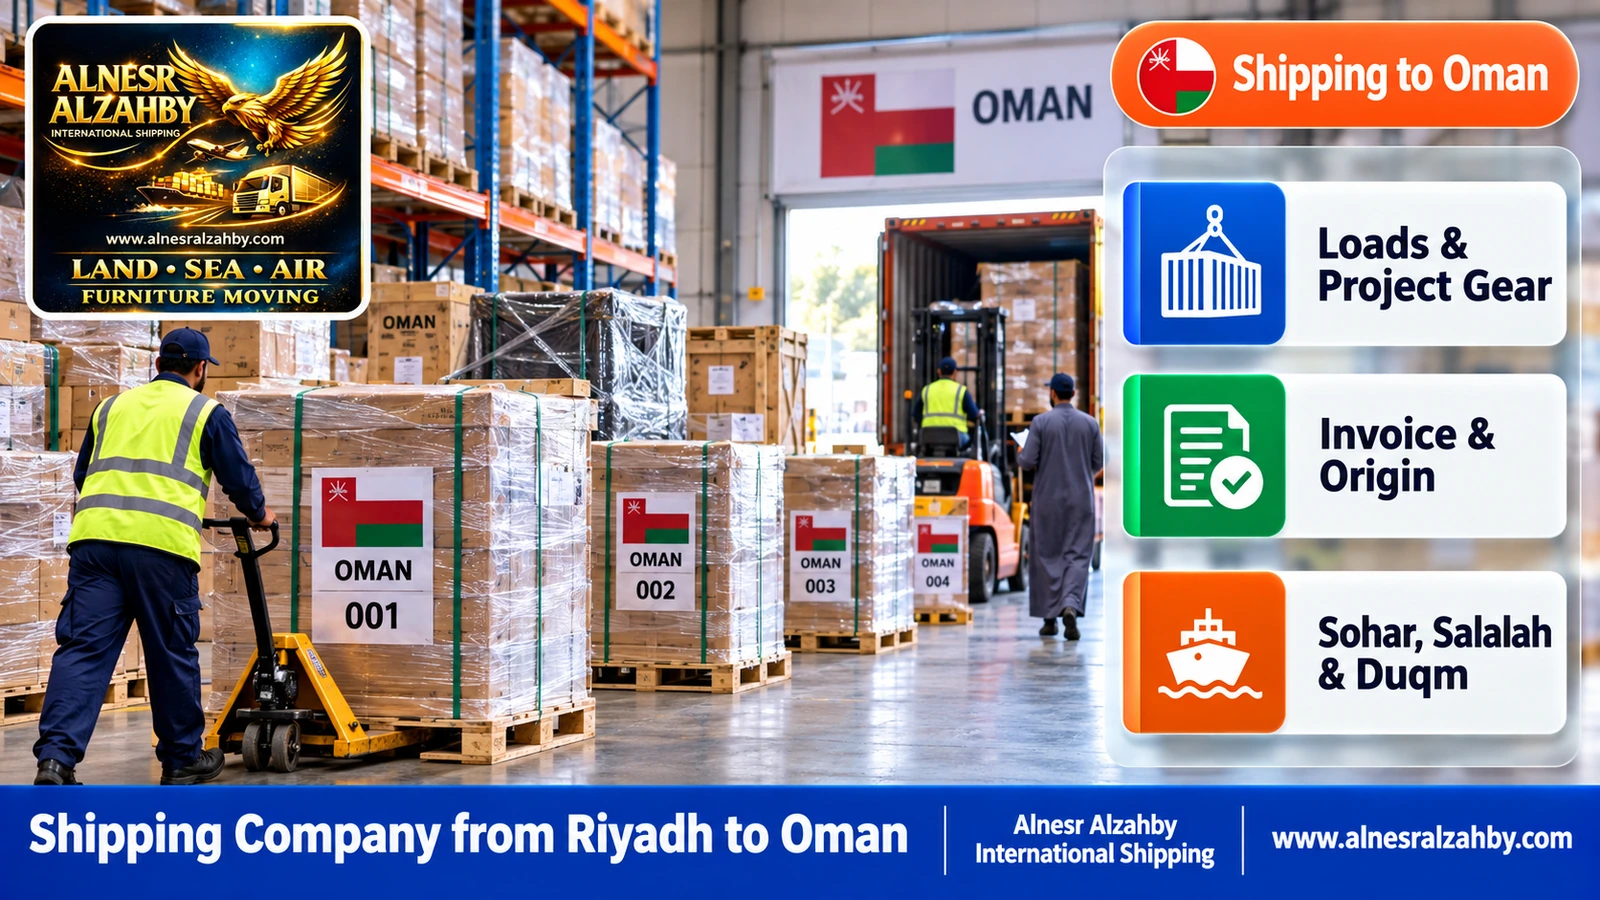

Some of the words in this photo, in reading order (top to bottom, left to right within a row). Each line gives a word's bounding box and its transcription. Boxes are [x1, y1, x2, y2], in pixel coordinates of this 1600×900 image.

[972, 84, 1092, 125] OMAN
[382, 314, 436, 330] OMAN
[629, 551, 682, 567] OMAN
[800, 557, 841, 569] OMAN
[921, 558, 955, 568] OMAN
[334, 559, 412, 582] OMAN
[636, 579, 676, 600] 002
[805, 578, 836, 594] 003
[925, 575, 950, 588] 004
[345, 601, 398, 630] 001
